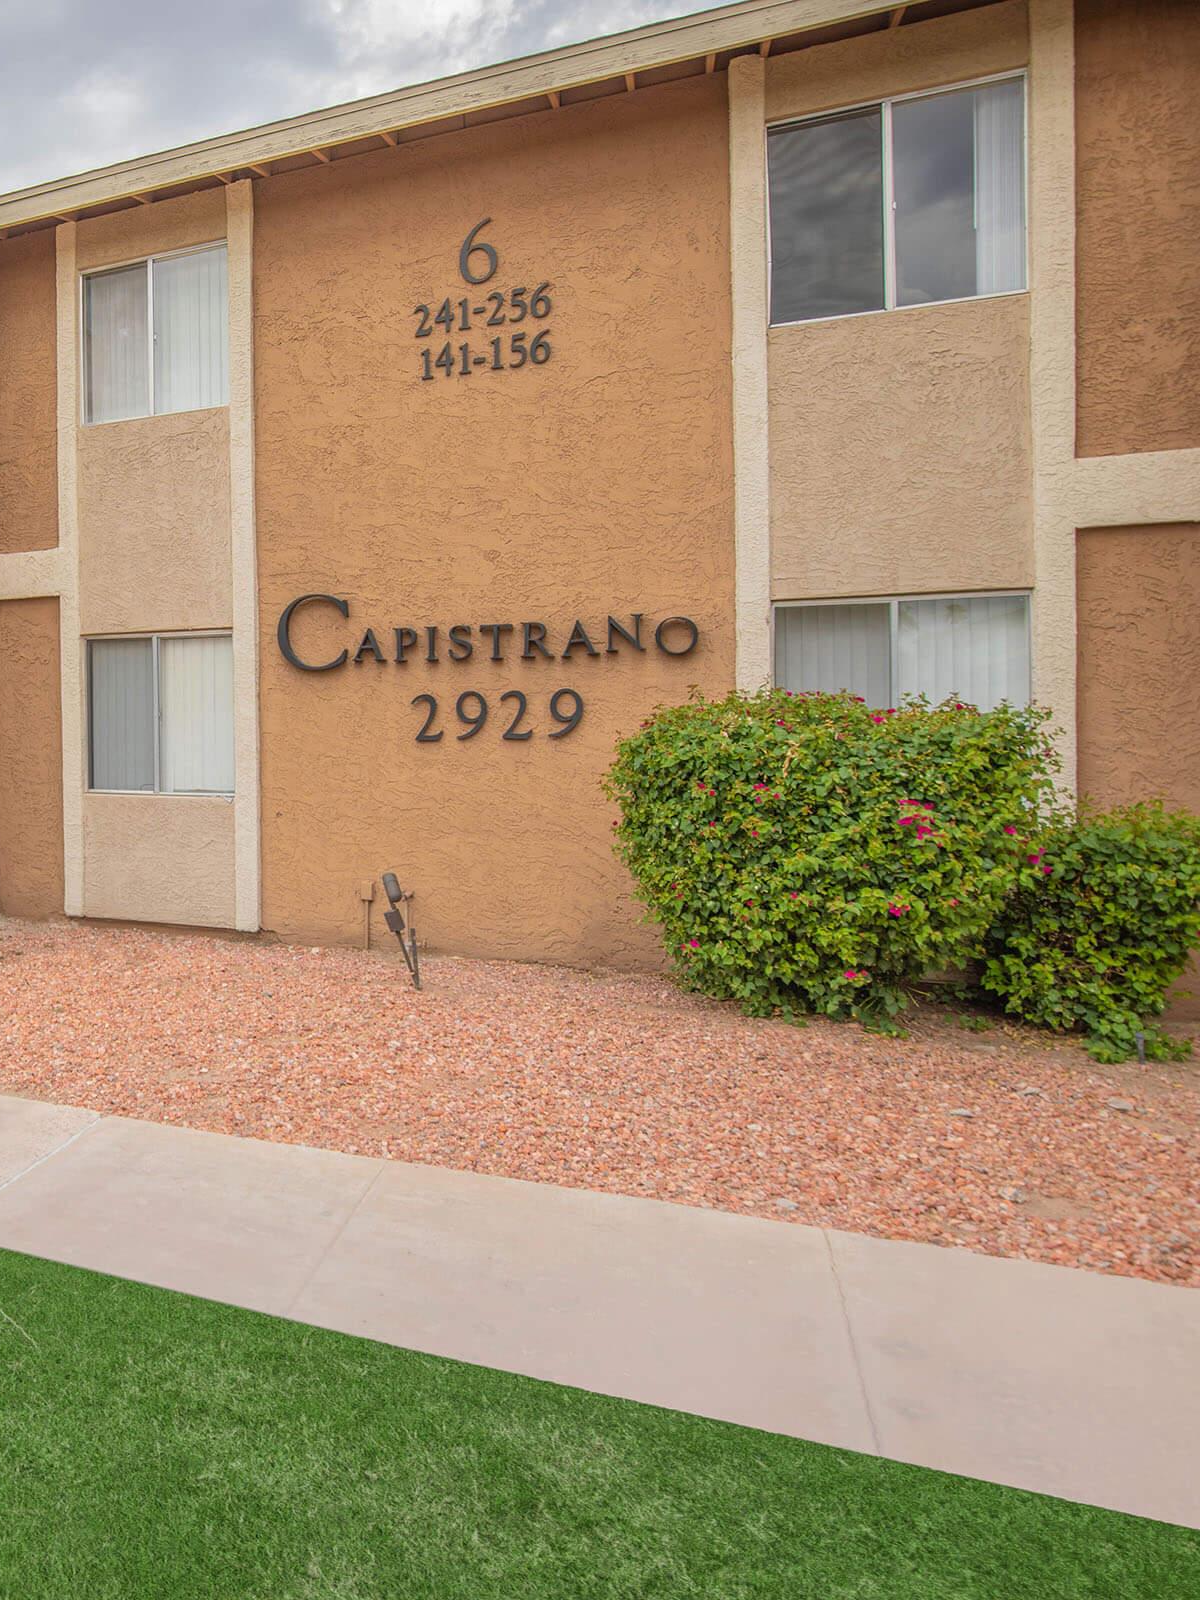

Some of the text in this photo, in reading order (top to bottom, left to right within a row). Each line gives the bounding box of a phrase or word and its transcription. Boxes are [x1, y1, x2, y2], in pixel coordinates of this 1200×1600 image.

[459, 218, 499, 285] 6
[413, 282, 552, 338] 241-256
[420, 330, 552, 381] 141-156
[276, 594, 700, 672] CAPISTRANO
[411, 688, 584, 742] 2929
